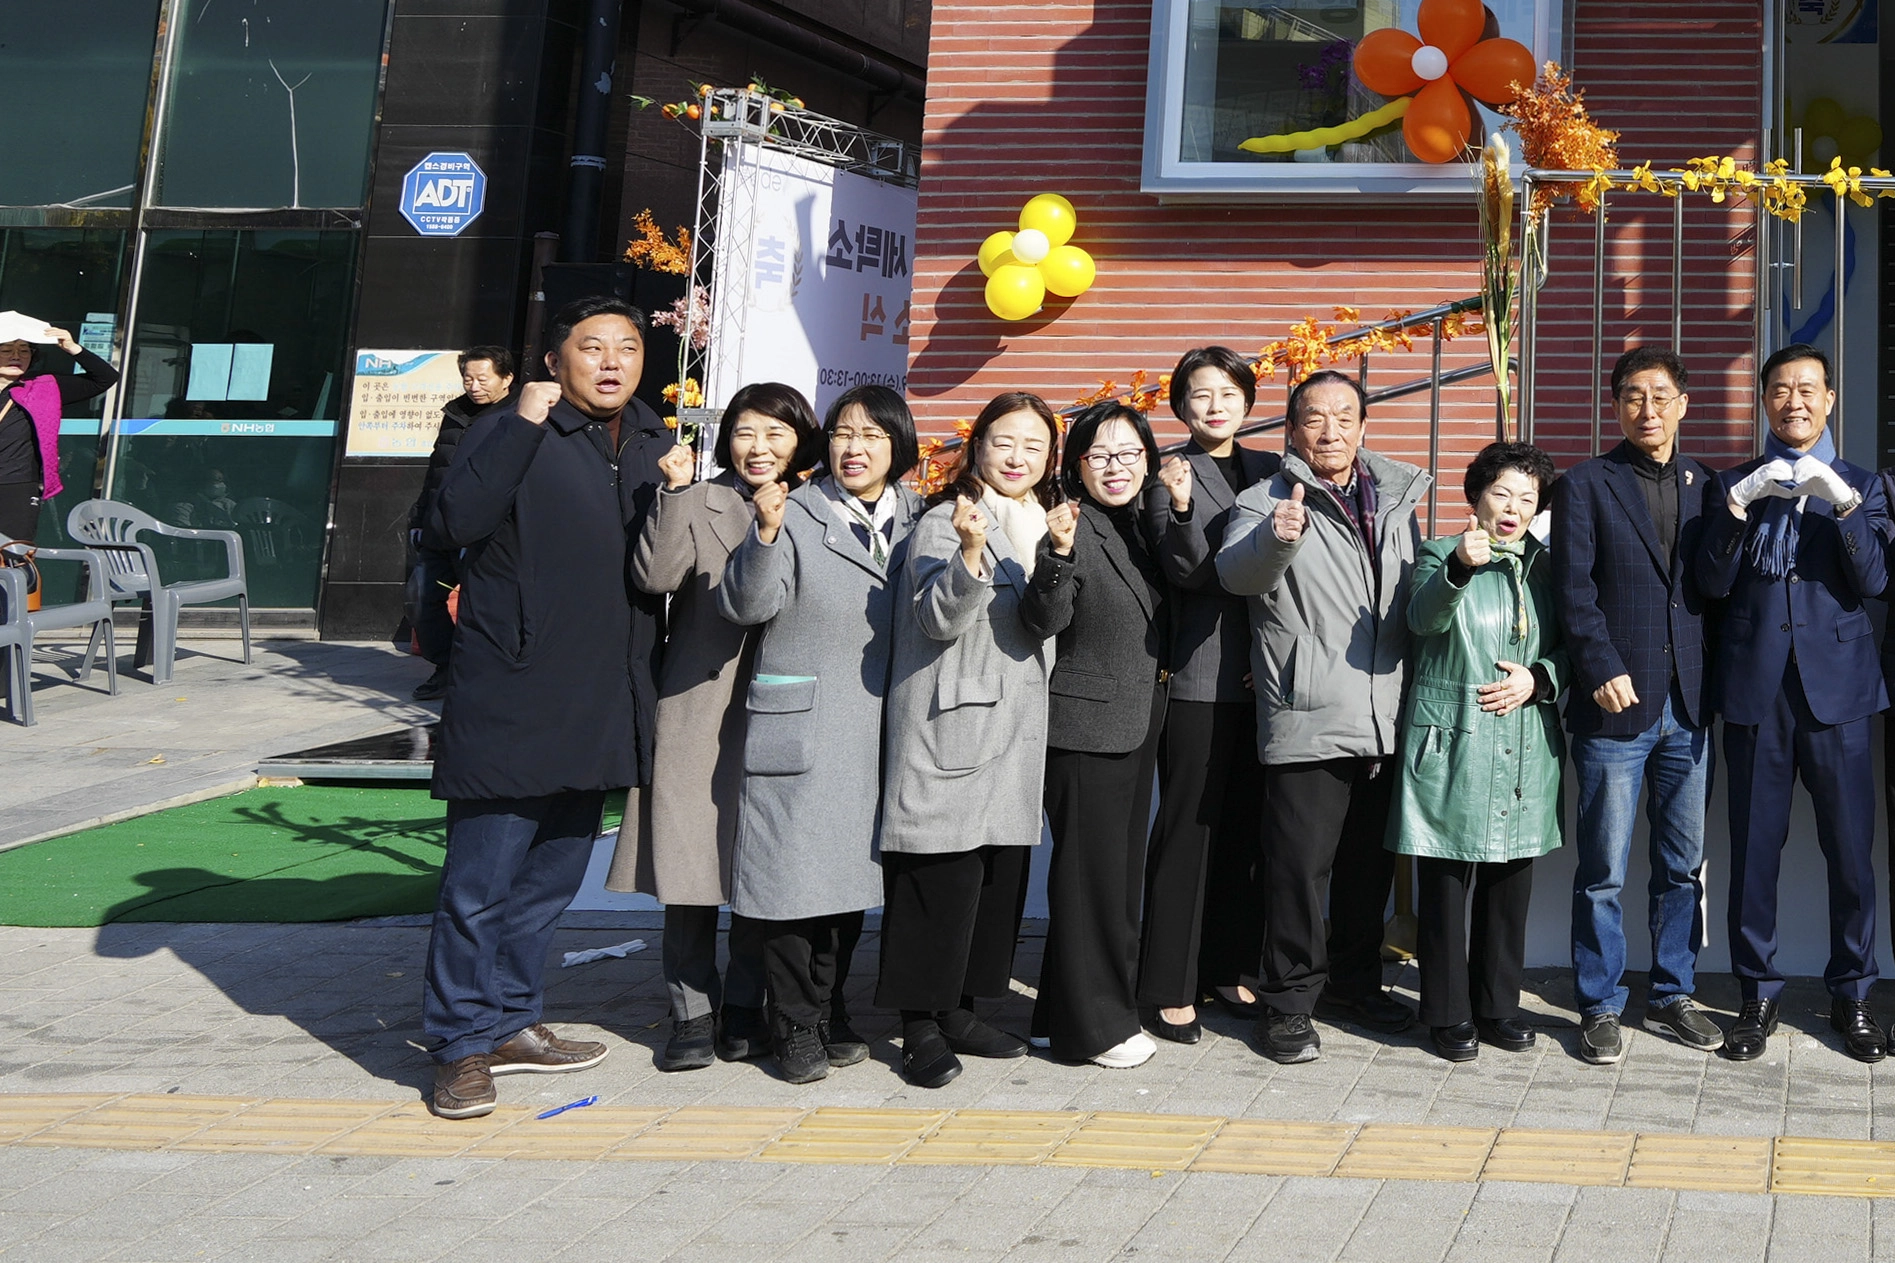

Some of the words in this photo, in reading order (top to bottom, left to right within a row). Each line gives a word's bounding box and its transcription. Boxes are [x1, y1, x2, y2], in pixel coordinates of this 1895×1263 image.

[415, 178, 474, 208] ADT
[365, 357, 392, 369] NH
[362, 382, 370, 391] 이
[374, 382, 389, 391] 곳은
[403, 393, 427, 403] 빈번한
[431, 394, 459, 403] 구역이
[399, 410, 423, 419] 영향이
[425, 410, 443, 419] 없도
[392, 421, 422, 431] 주차하여
